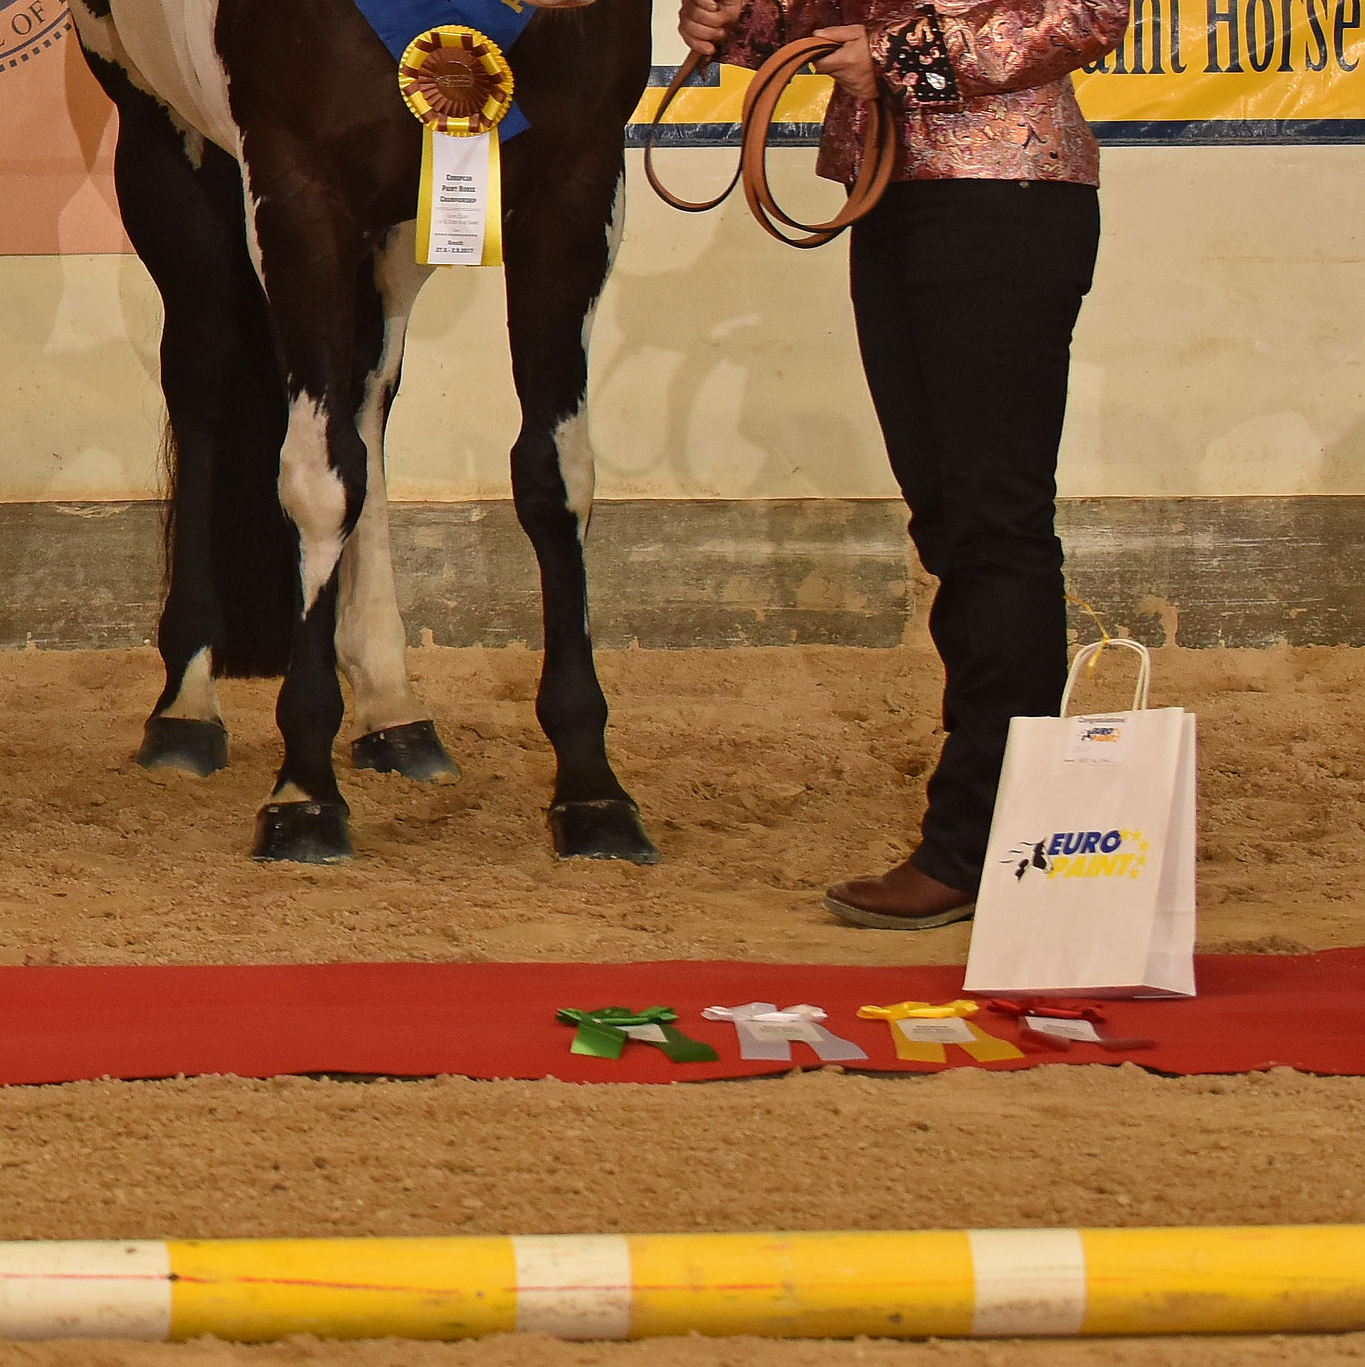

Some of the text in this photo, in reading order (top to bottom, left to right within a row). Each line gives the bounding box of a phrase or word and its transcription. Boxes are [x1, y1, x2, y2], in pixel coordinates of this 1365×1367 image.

[11, 2, 52, 38] OF
[1047, 830, 1122, 855] EURO
[1046, 853, 1136, 880] PAINT
